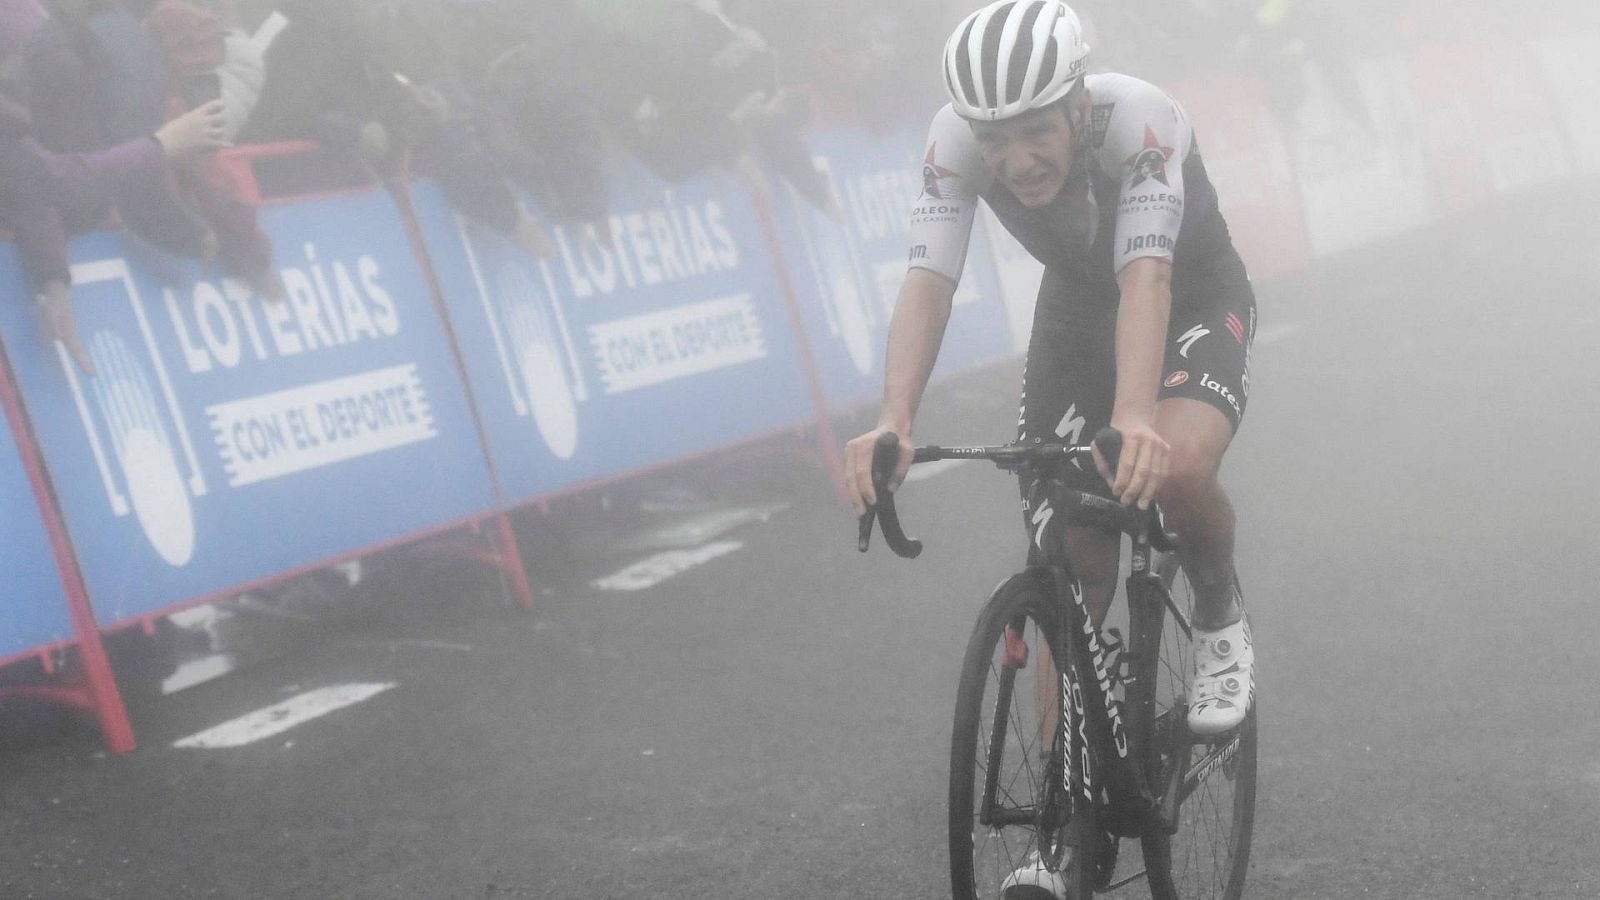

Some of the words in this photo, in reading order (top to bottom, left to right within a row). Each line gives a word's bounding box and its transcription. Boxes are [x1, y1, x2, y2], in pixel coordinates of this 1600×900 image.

[555, 188, 738, 298] LOTERÍAS
[912, 206, 960, 216] OLEON
[163, 240, 398, 374] LOTERÍAS
[231, 410, 288, 464] CON
[284, 407, 320, 451] EL
[316, 384, 419, 443] DEPORTE
